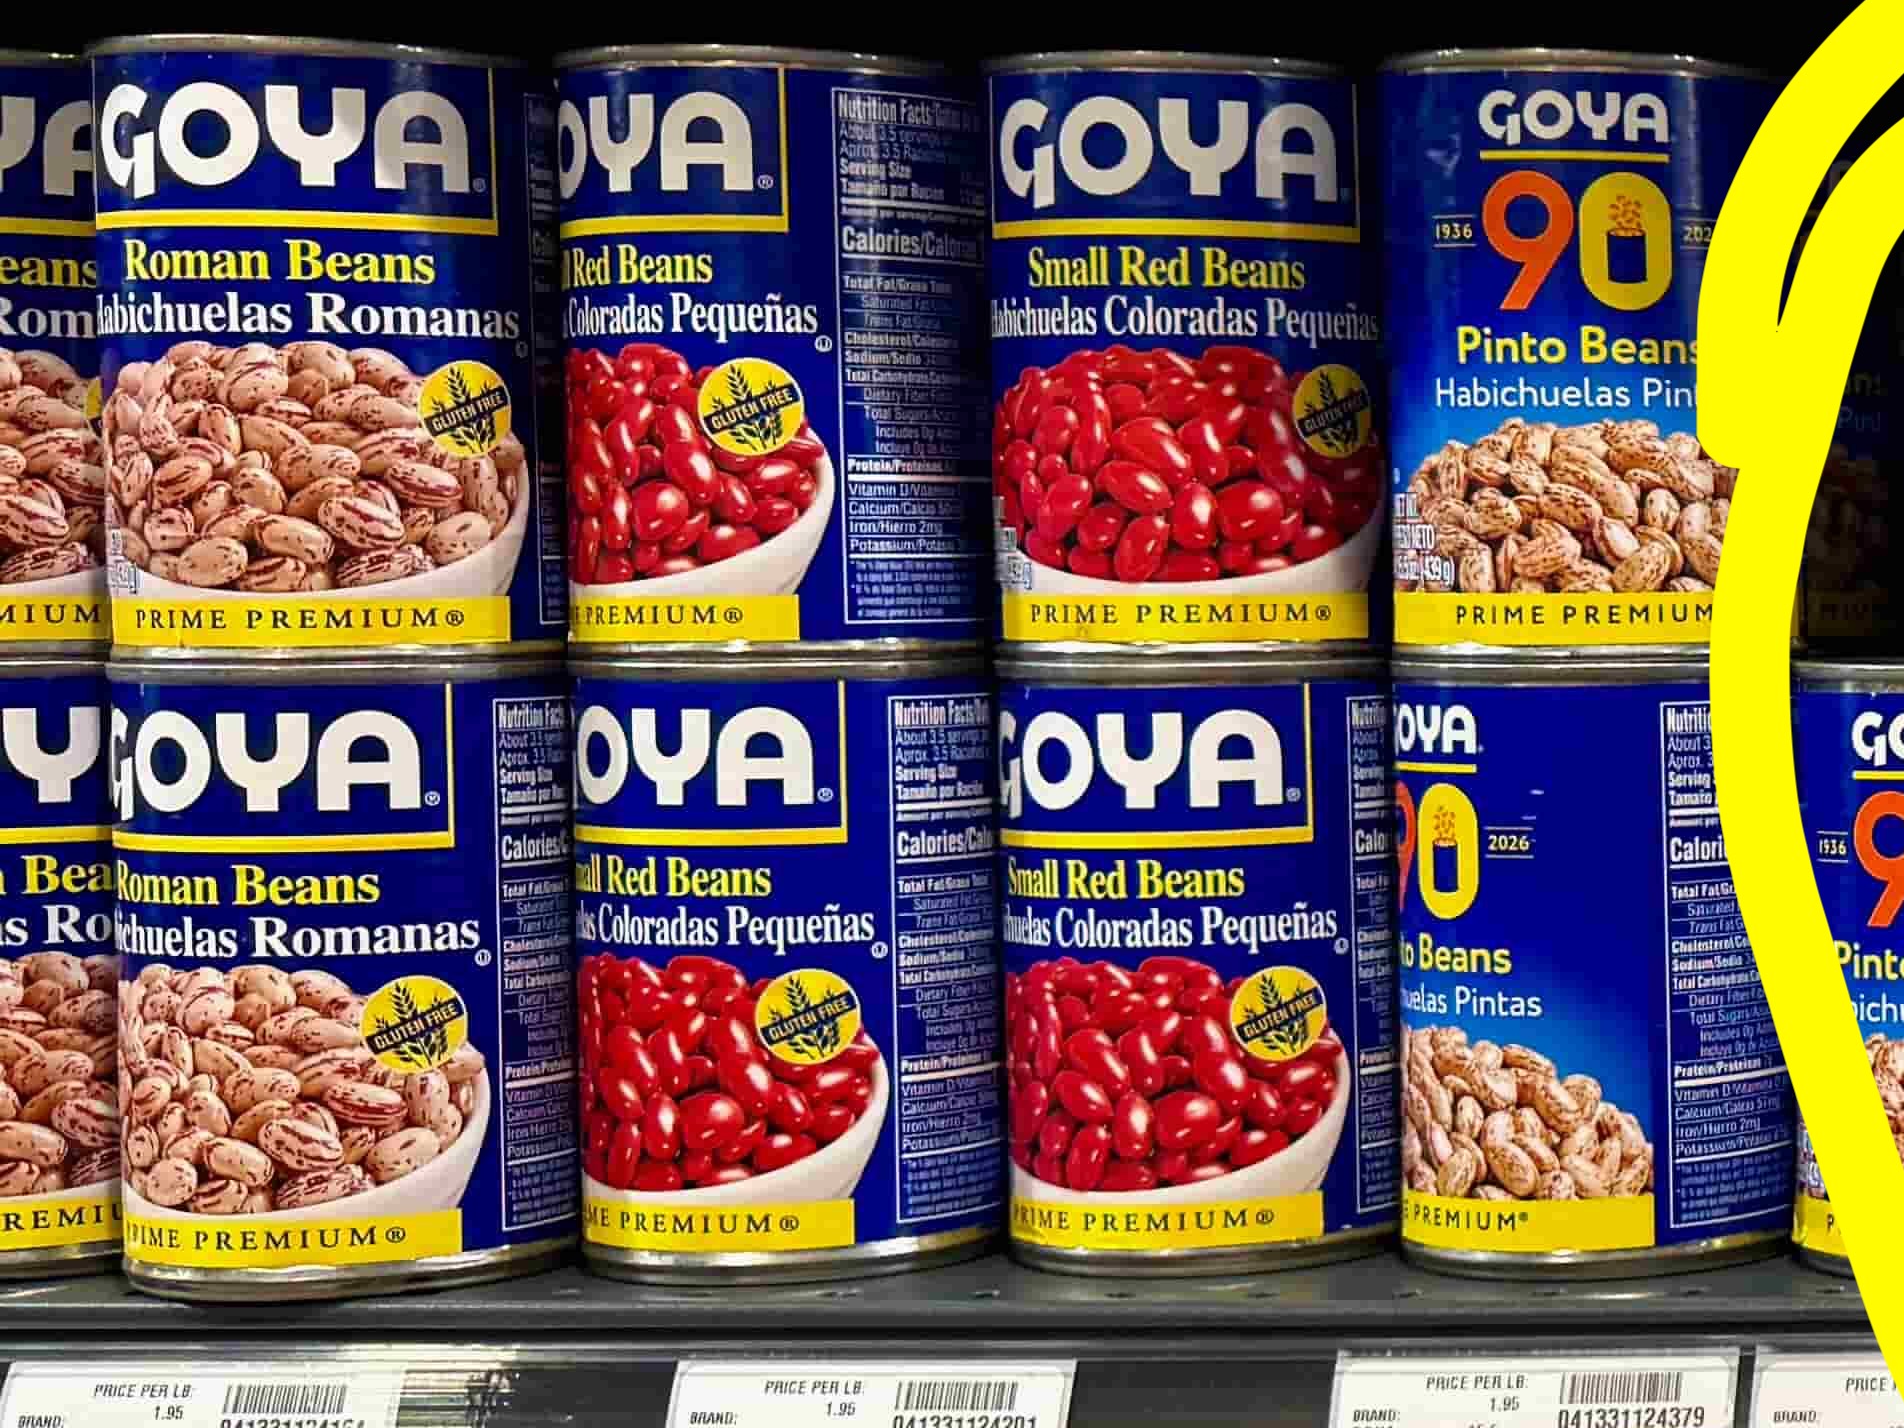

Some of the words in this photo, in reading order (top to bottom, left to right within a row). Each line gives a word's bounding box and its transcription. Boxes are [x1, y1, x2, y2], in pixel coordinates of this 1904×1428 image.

[100, 82, 473, 201] GOYA
[1432, 222, 1476, 243] 1936
[123, 241, 275, 283] Roman
[287, 243, 437, 286] Beans
[1027, 247, 1110, 291] Small
[1119, 247, 1191, 288] Red
[1200, 247, 1306, 292] Beans
[309, 292, 521, 342] Romanas
